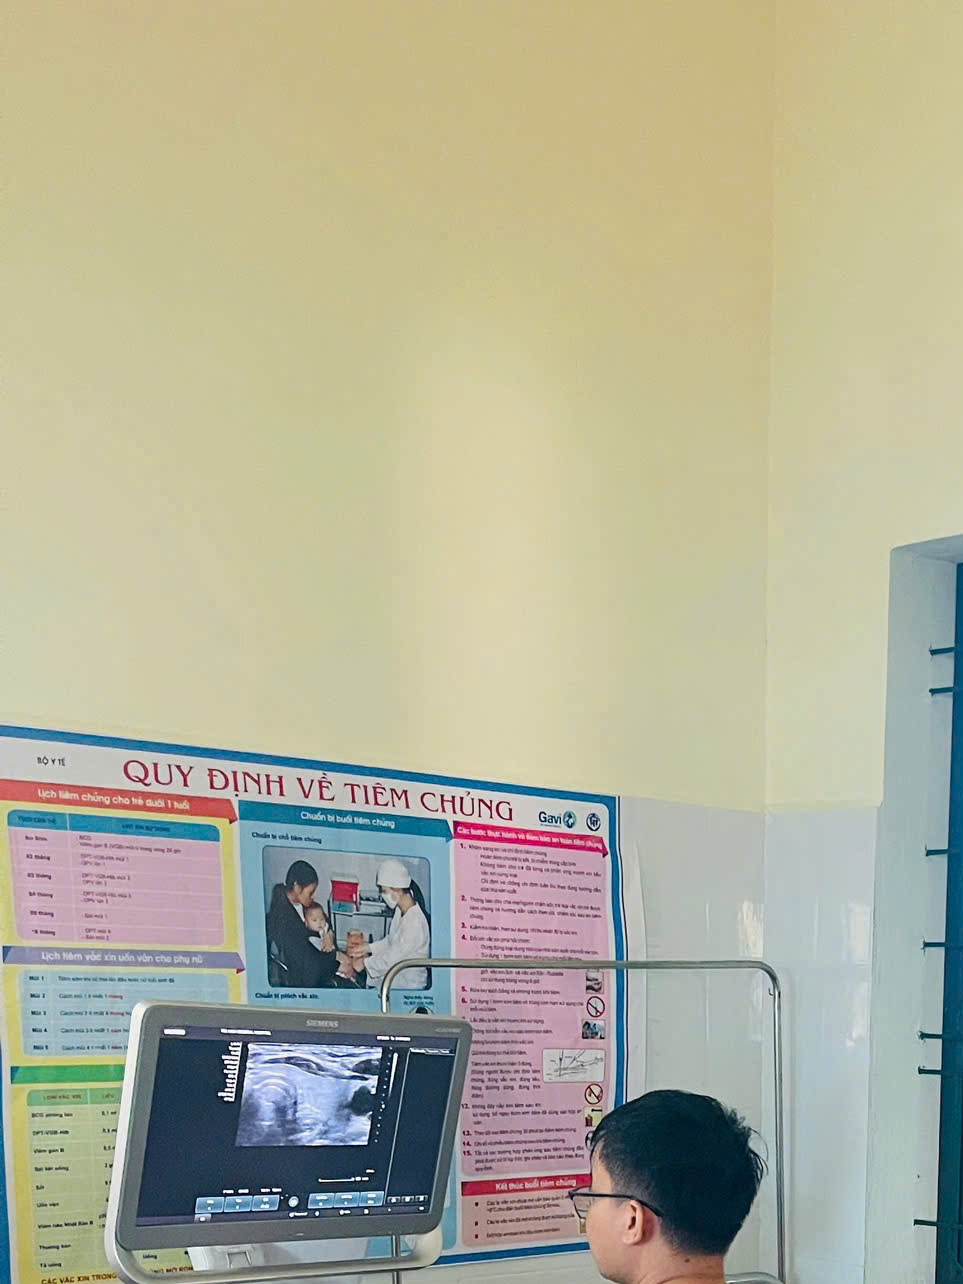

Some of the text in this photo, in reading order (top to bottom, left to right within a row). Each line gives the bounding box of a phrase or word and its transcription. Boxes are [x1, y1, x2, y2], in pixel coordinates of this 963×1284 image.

[37, 756, 49, 766] BỘ
[123, 759, 513, 822] QUY ĐỊNH VỀ TIÊM CHỦNG
[38, 789, 56, 800] Lịch
[58, 790, 79, 800] tiêm
[82, 792, 110, 805] chủng
[112, 795, 130, 805] cho
[131, 795, 144, 806] trẻ
[168, 800, 172, 808] 1
[300, 811, 395, 829] Chuẩn bị buổi tiêm chủng
[538, 811, 562, 825] Gavi
[41, 951, 61, 962] Lịch
[62, 952, 82, 961] tiêm
[84, 952, 101, 961] vắc
[104, 953, 117, 961] xin
[118, 953, 135, 962] uốn
[137, 954, 153, 962] ván
[155, 954, 172, 963] cho
[174, 955, 190, 965] phụ
[306, 1019, 339, 1028] SIEMENS
[91, 1272, 118, 1281] TRONG
